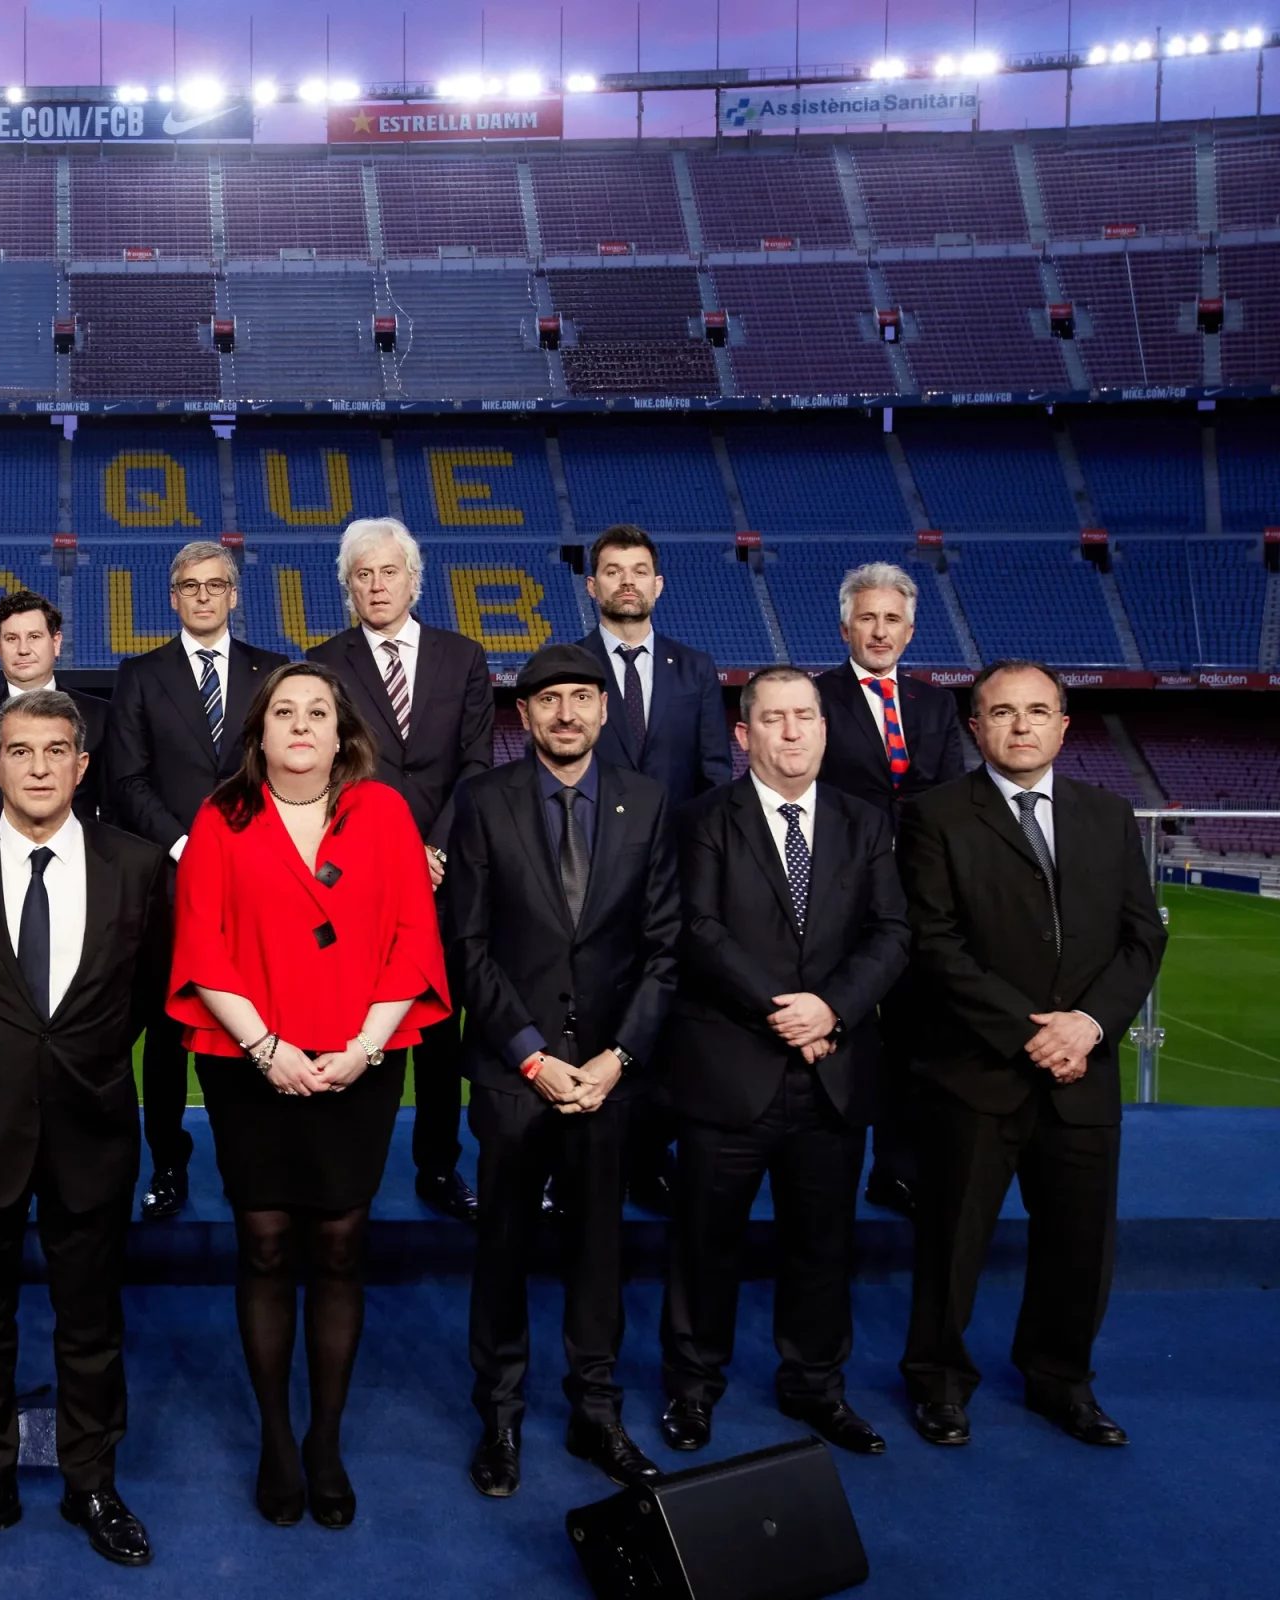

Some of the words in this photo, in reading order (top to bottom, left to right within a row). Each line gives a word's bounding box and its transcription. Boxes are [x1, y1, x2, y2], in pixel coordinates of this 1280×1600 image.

[760, 97, 880, 117] Assistència
[883, 92, 976, 111] Sanitària
[379, 112, 472, 133] ESTRELLA
[476, 111, 538, 130] DAMM
[36, 402, 90, 411] NIKE.COM/FCB
[184, 402, 237, 411] NIKE.COM/FCB
[332, 401, 385, 411] NIKE.COM/FCB
[482, 400, 536, 410] NIKE.COM/FCB
[634, 398, 690, 408] NIKE.COM/FCB
[104, 450, 523, 528] QUE
[931, 672, 975, 683] Rakuten
[1161, 675, 1192, 684] Rakuten
[1199, 674, 1248, 685] Rakuten
